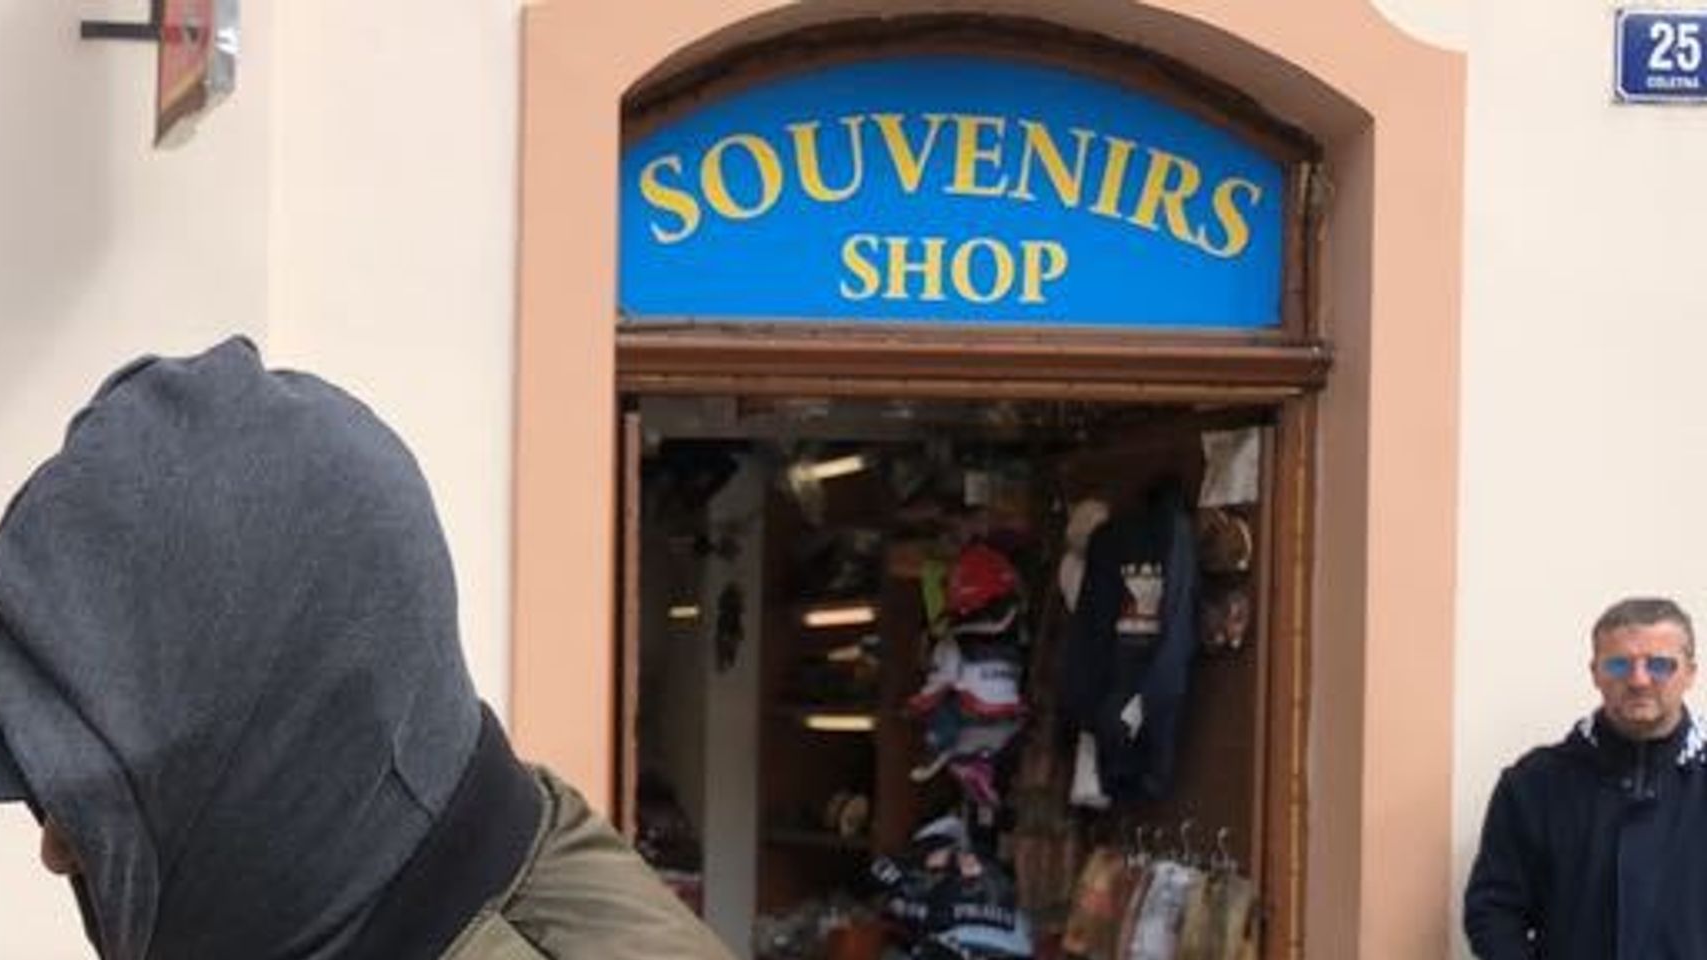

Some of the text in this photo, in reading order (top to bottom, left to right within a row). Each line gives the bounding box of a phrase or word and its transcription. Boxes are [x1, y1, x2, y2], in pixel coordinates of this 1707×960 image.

[1648, 21, 1702, 72] 25
[638, 113, 1262, 260] SOUVENIRS
[839, 234, 1069, 304] SHOP
